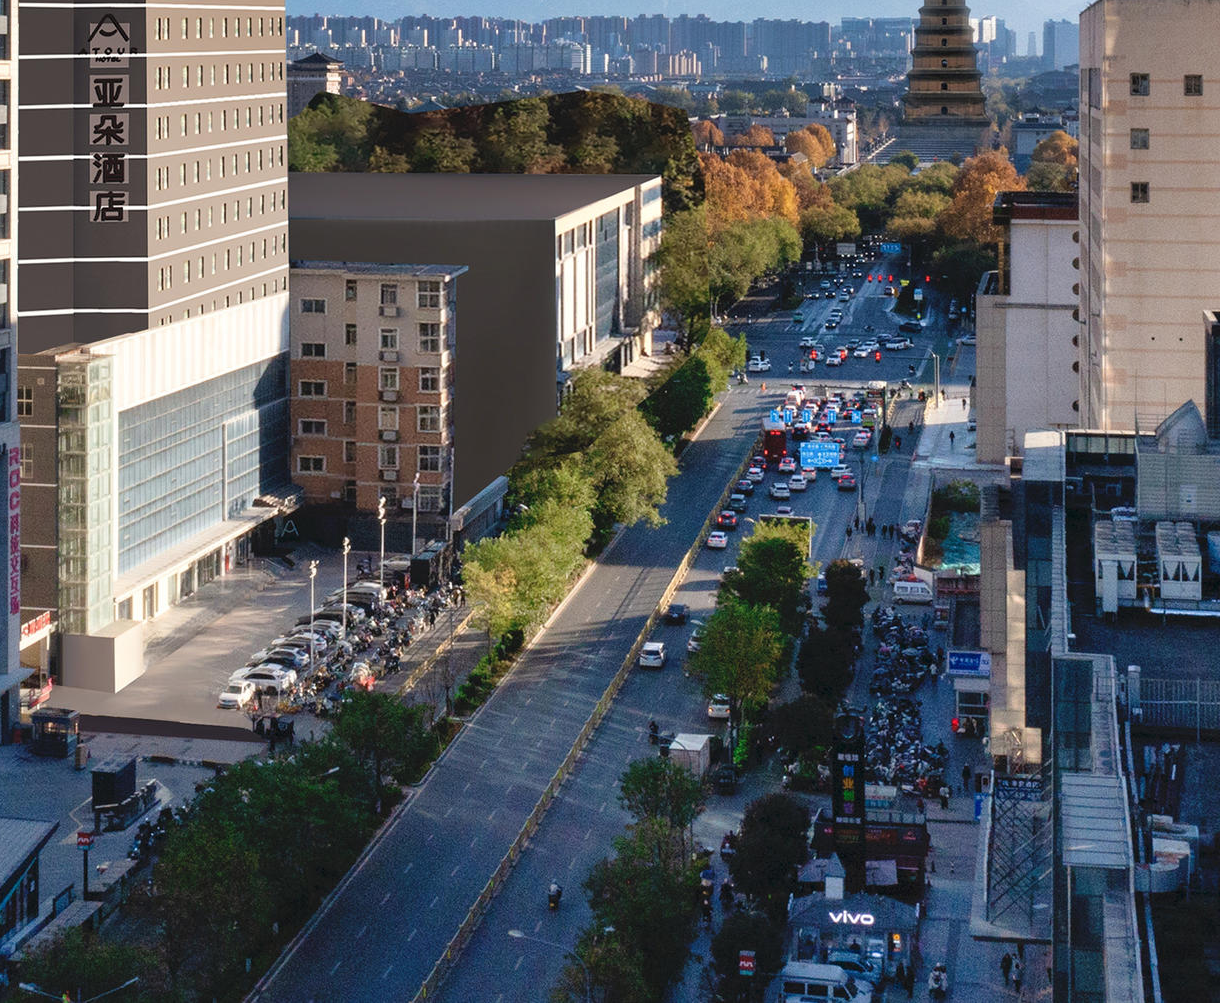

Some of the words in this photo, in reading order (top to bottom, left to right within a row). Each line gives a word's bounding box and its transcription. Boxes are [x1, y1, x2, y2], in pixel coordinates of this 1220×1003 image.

[93, 78, 125, 222] 亚朵酒店
[829, 910, 875, 925] vivo
